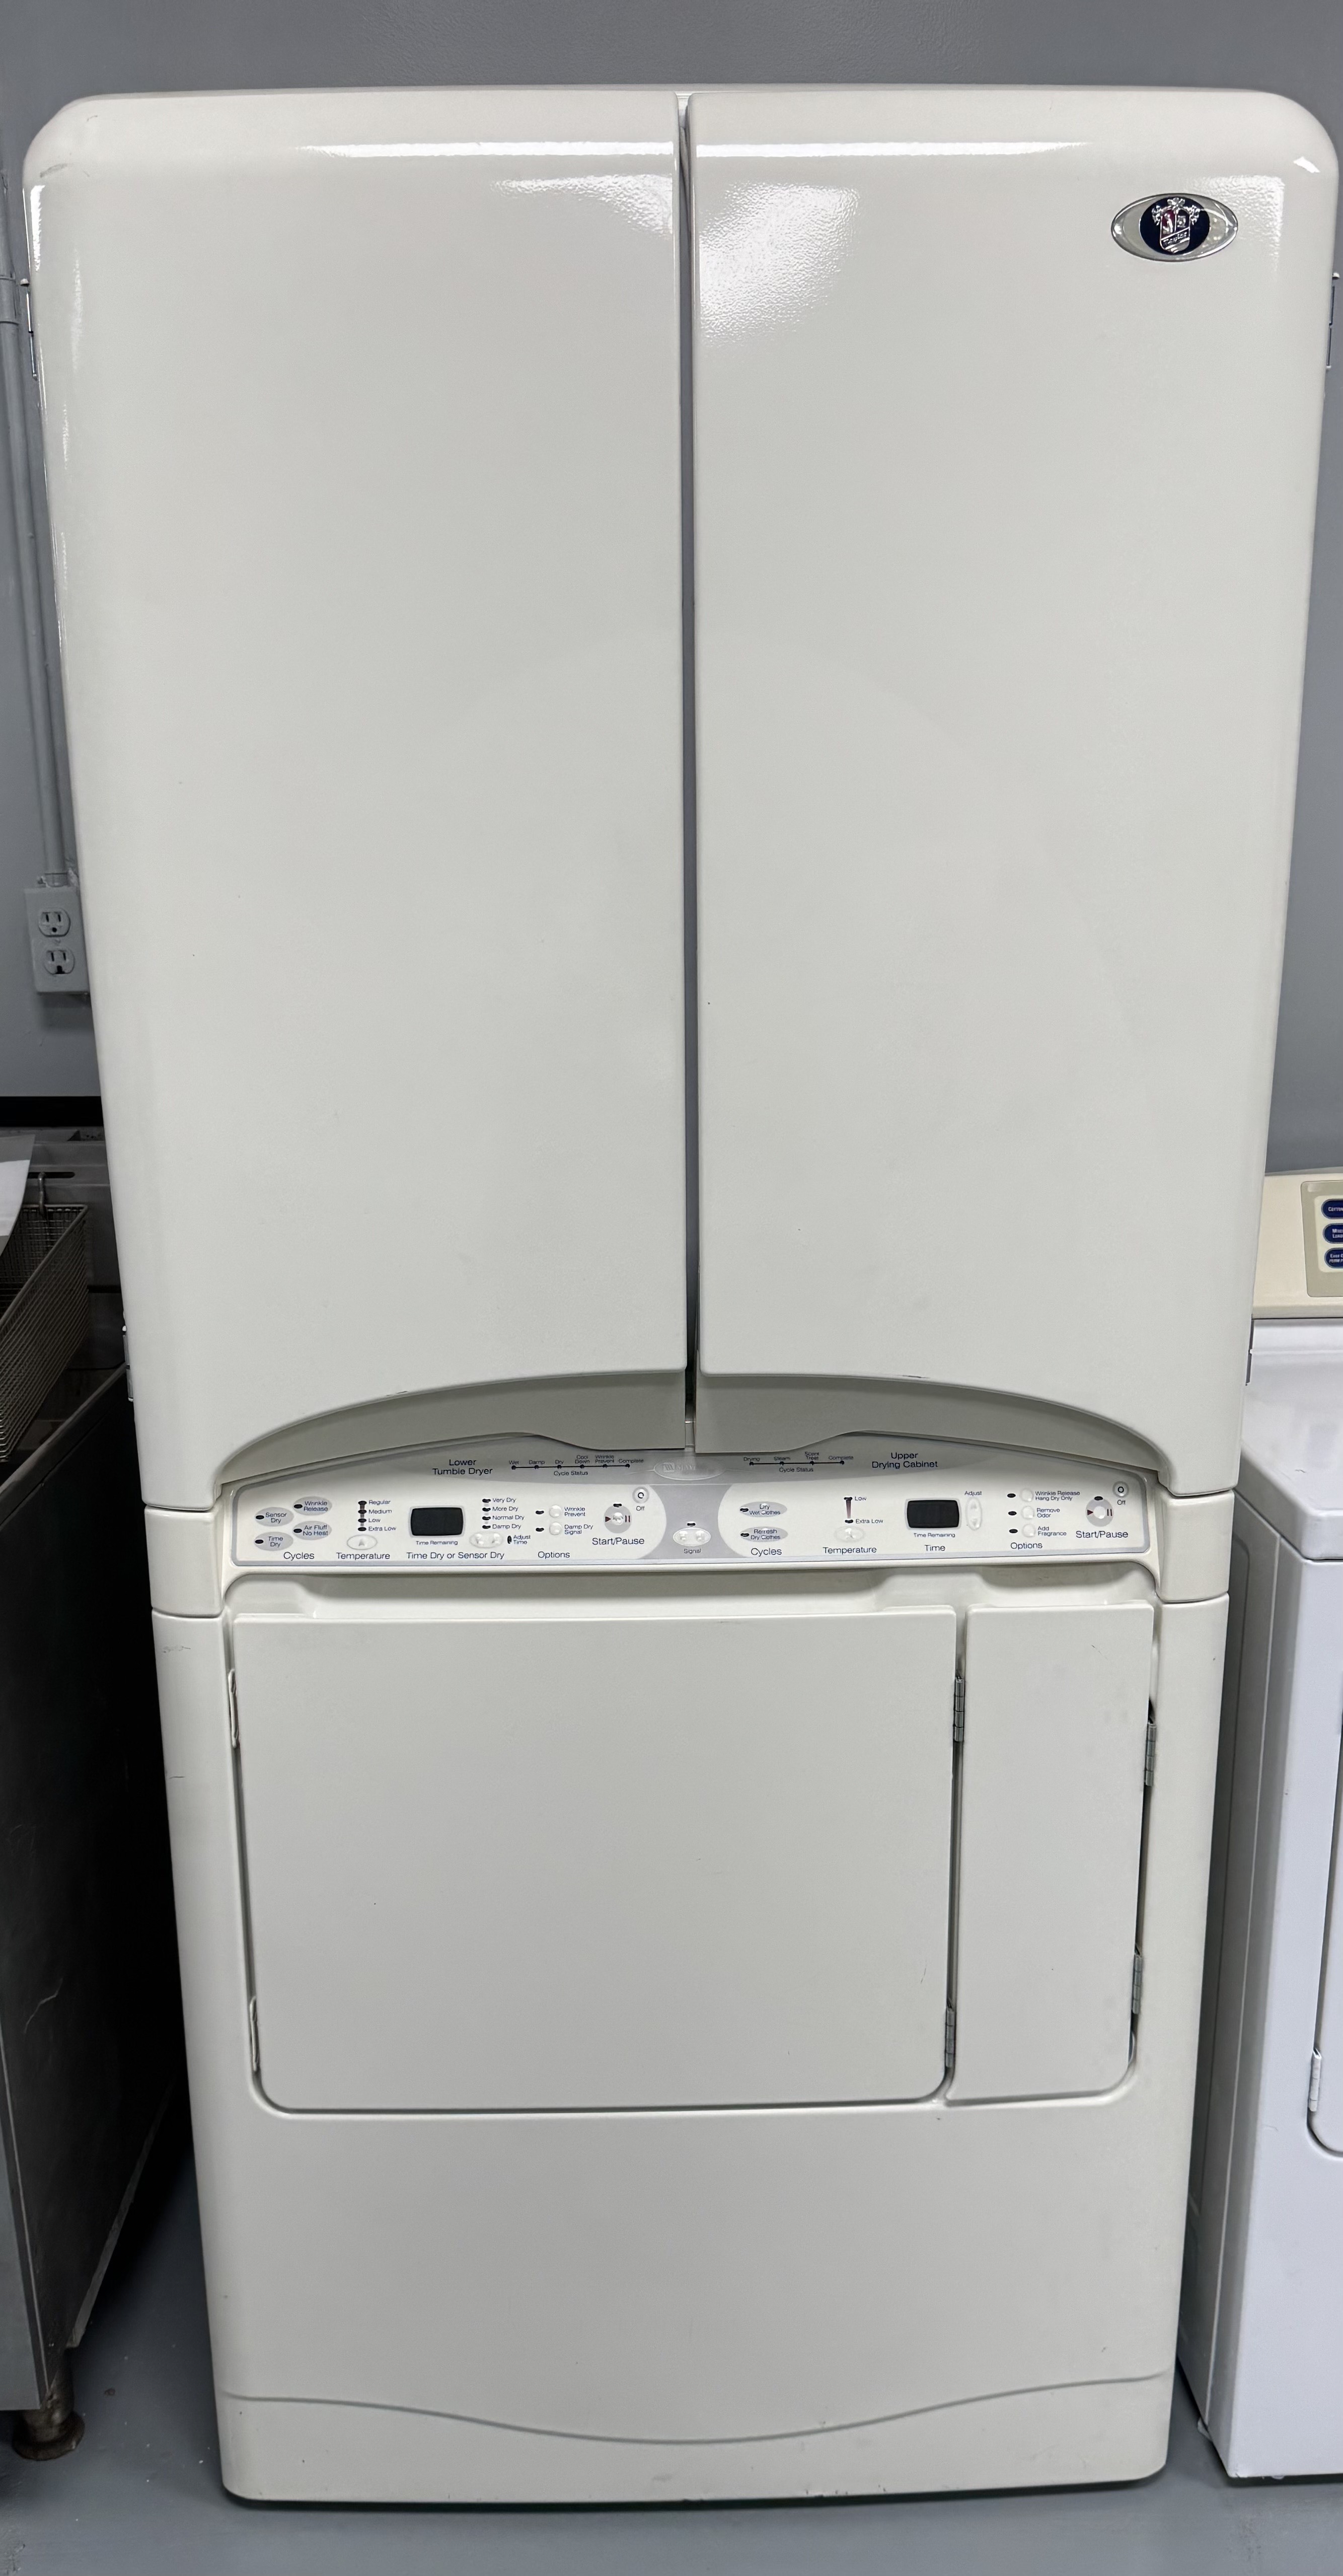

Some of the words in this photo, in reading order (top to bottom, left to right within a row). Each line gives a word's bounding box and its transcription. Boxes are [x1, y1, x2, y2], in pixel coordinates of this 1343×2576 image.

[872, 1461, 900, 1469] Drying
[468, 1467, 493, 1475] Dryer
[1076, 1530, 1129, 1539] Start/Pause
[592, 1537, 645, 1545] Start/Pause
[751, 1548, 782, 1557] Cycles
[824, 1547, 877, 1555] Temperature
[283, 1551, 315, 1560] Cycles
[336, 1552, 391, 1560] Temperature
[430, 1552, 444, 1560] Dry
[491, 1551, 504, 1560] Dry
